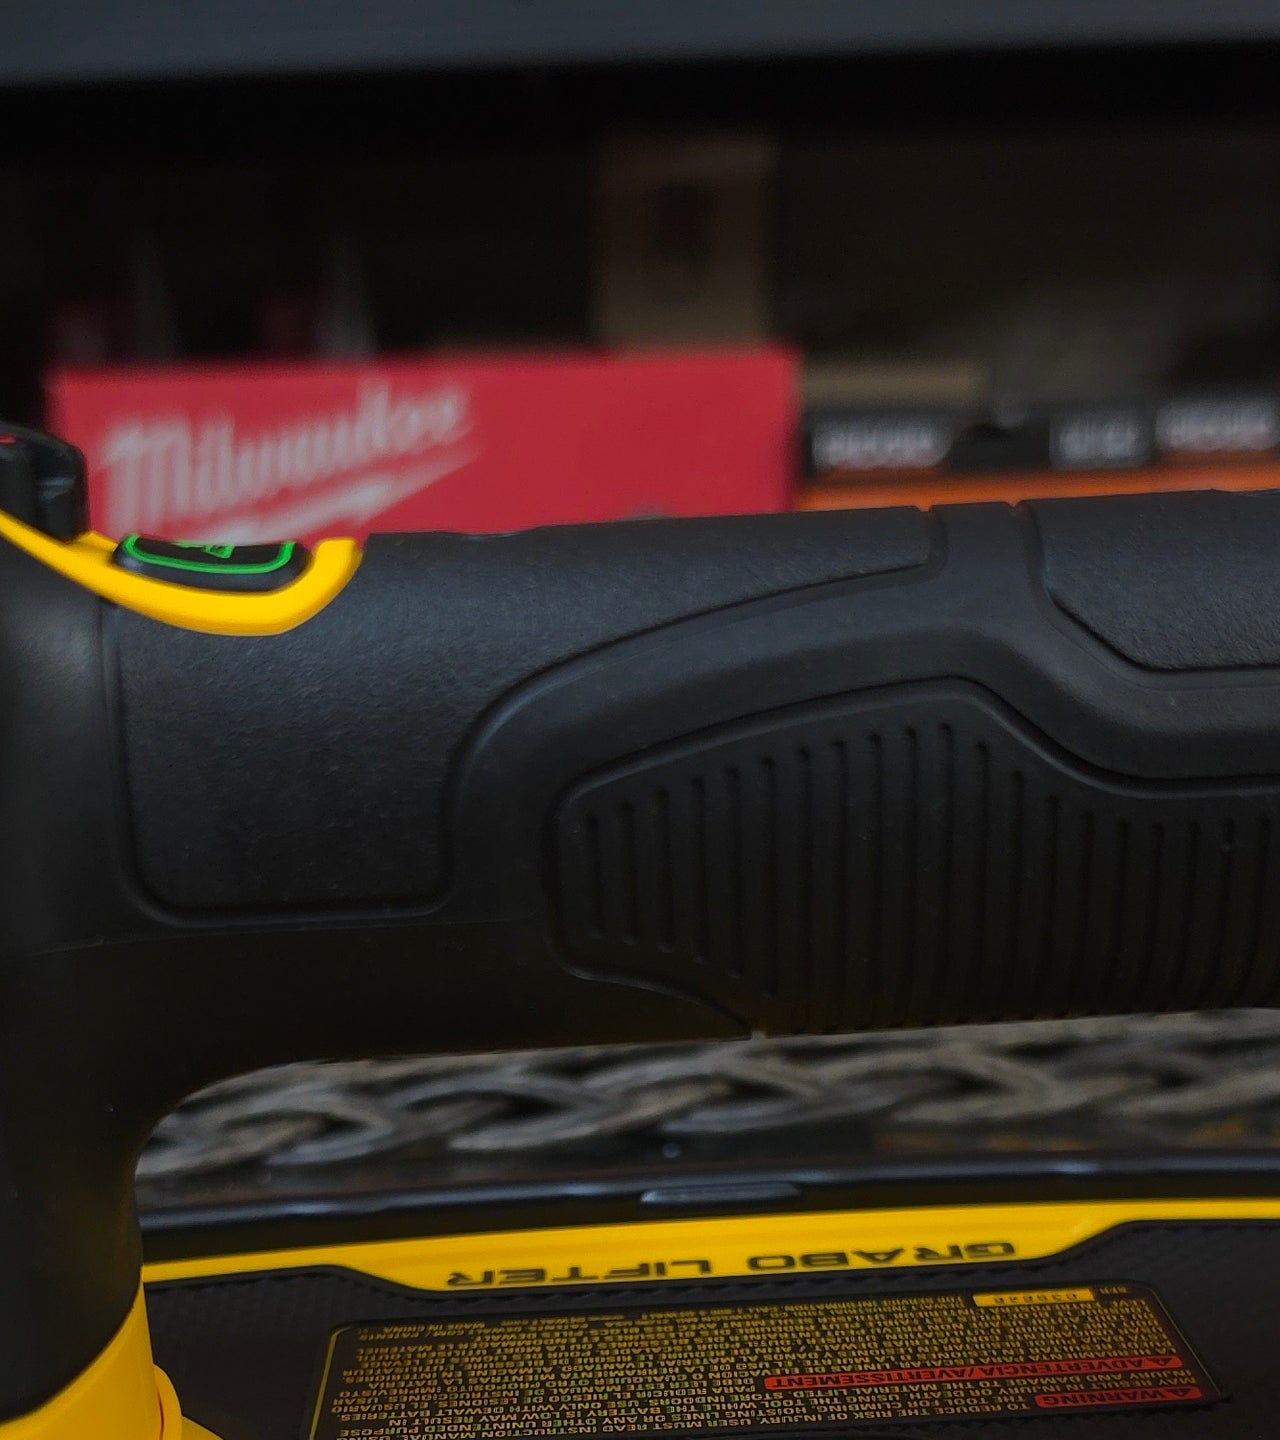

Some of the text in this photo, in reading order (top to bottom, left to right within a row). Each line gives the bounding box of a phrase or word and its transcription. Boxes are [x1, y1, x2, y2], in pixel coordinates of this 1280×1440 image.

[446, 1241, 1016, 1288] GRABO LIFTER
[1085, 1374, 1124, 1382] AND
[1156, 1377, 1200, 1386] MAY
[549, 1385, 622, 1395] MANUAL
[711, 1386, 757, 1395] PARA
[853, 1384, 939, 1395] MATERIAL
[942, 1382, 975, 1390] THE
[997, 1385, 1062, 1395] INJURY
[729, 1393, 785, 1402] STORE
[969, 1389, 994, 1397] OR
[809, 1397, 841, 1406] THE
[845, 1394, 901, 1404] USING
[944, 1397, 989, 1406] TOOL
[995, 1395, 1026, 1404] THE
[1040, 1390, 1166, 1406] WARNING
[559, 1402, 603, 1411] ONLY
[607, 1400, 640, 1408] USE
[701, 1402, 758, 1411] WHILE
[760, 1399, 805, 1408] TOOL
[907, 1400, 941, 1408] FOR
[1007, 1403, 1031, 1411] TO
[435, 1407, 505, 1417] DEWALT
[510, 1404, 555, 1413] WITH
[587, 1407, 662, 1417] BATTERY
[666, 1405, 698, 1413] THE
[725, 1407, 808, 1418] HOISTING
[897, 1409, 931, 1417] THE
[935, 1405, 1003, 1415] REDUCE
[479, 1414, 518, 1423] MAY
[522, 1412, 562, 1421] LOW
[565, 1411, 582, 1419] IS
[643, 1414, 667, 1422] OR
[672, 1412, 721, 1421] LINES
[827, 1413, 849, 1421] OF
[853, 1411, 893, 1419] RISK
[412, 1416, 474, 1426] RESULT
[541, 1418, 598, 1428] OTHER
[603, 1416, 639, 1424] ANY
[707, 1418, 752, 1427] USER
[425, 1421, 538, 1433] UNINTENDED
[603, 1423, 648, 1433] READ
[653, 1421, 703, 1430] MUST
[340, 1427, 420, 1437] PURPOSE
[482, 1426, 598, 1439] INSTRUCTION
